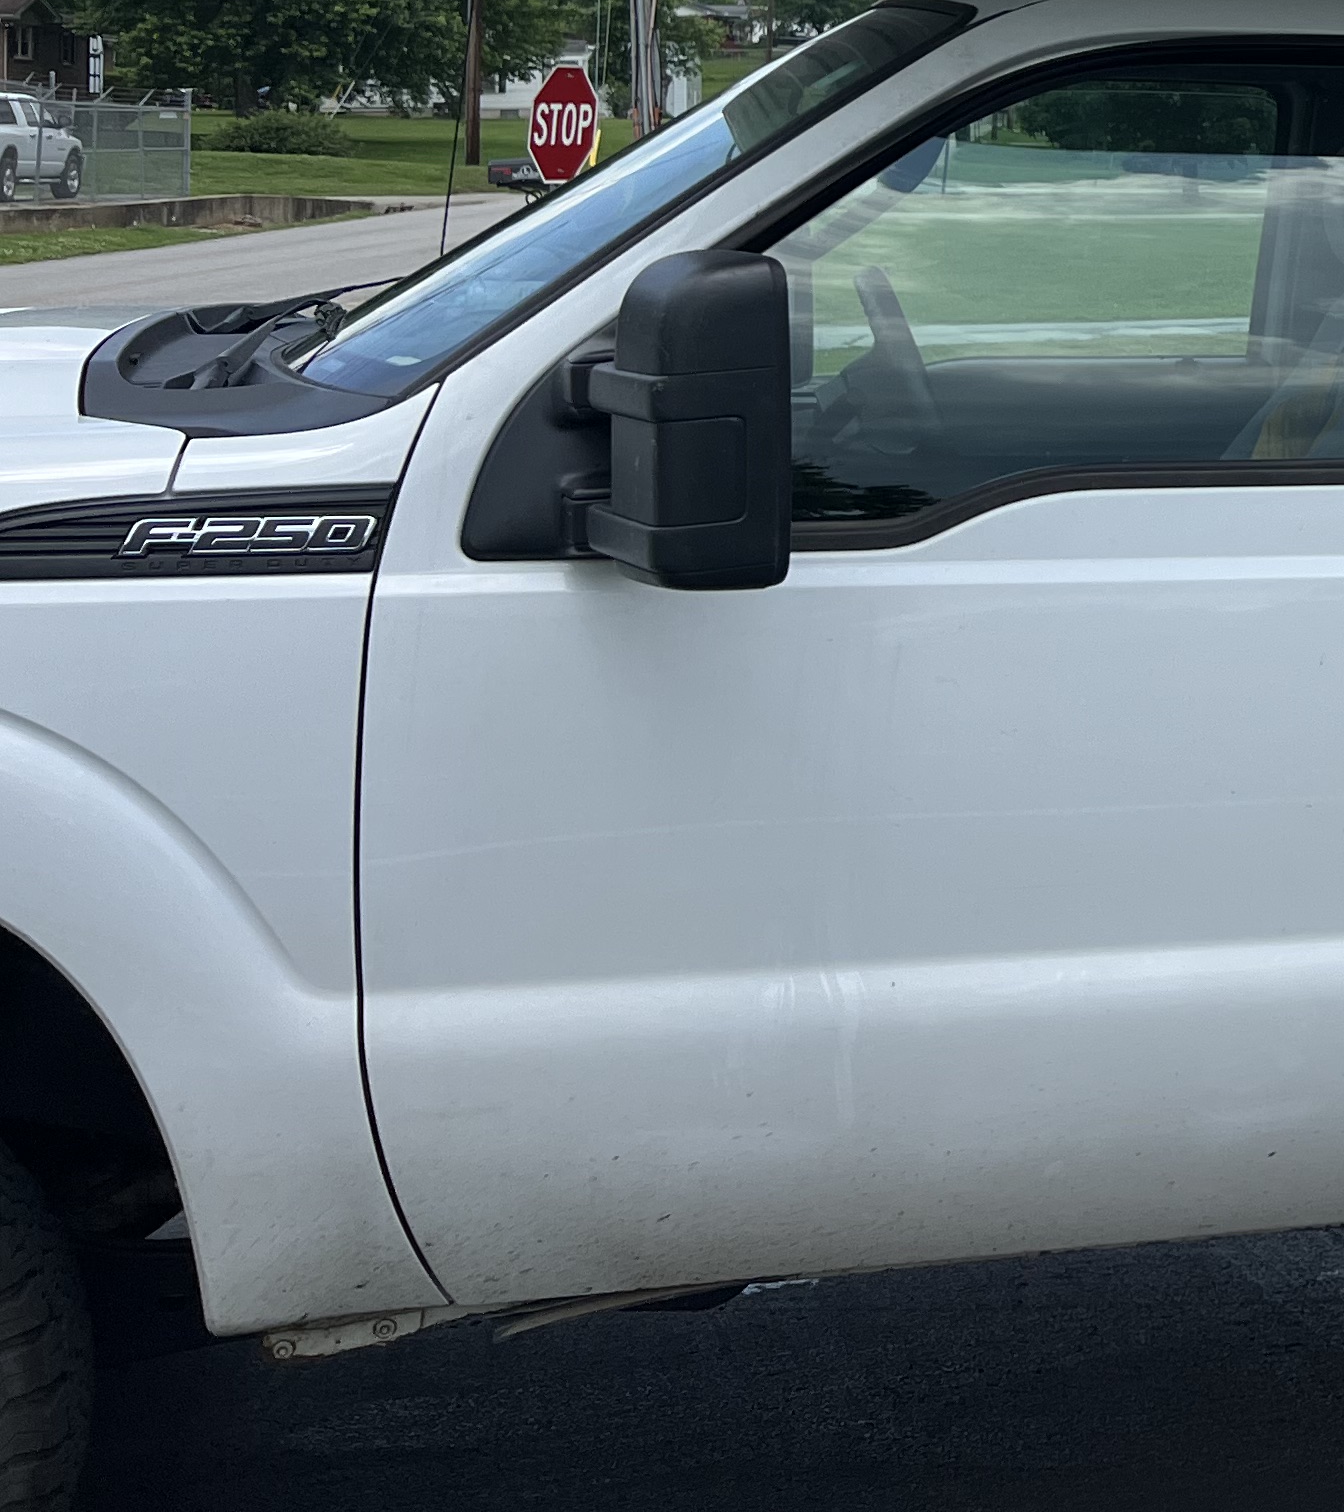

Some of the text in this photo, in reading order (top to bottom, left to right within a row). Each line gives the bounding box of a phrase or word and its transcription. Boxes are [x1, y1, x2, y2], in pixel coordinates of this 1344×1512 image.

[533, 102, 593, 147] STOP
[118, 515, 378, 557] F-250
[120, 556, 363, 572] SUPER DUTY
